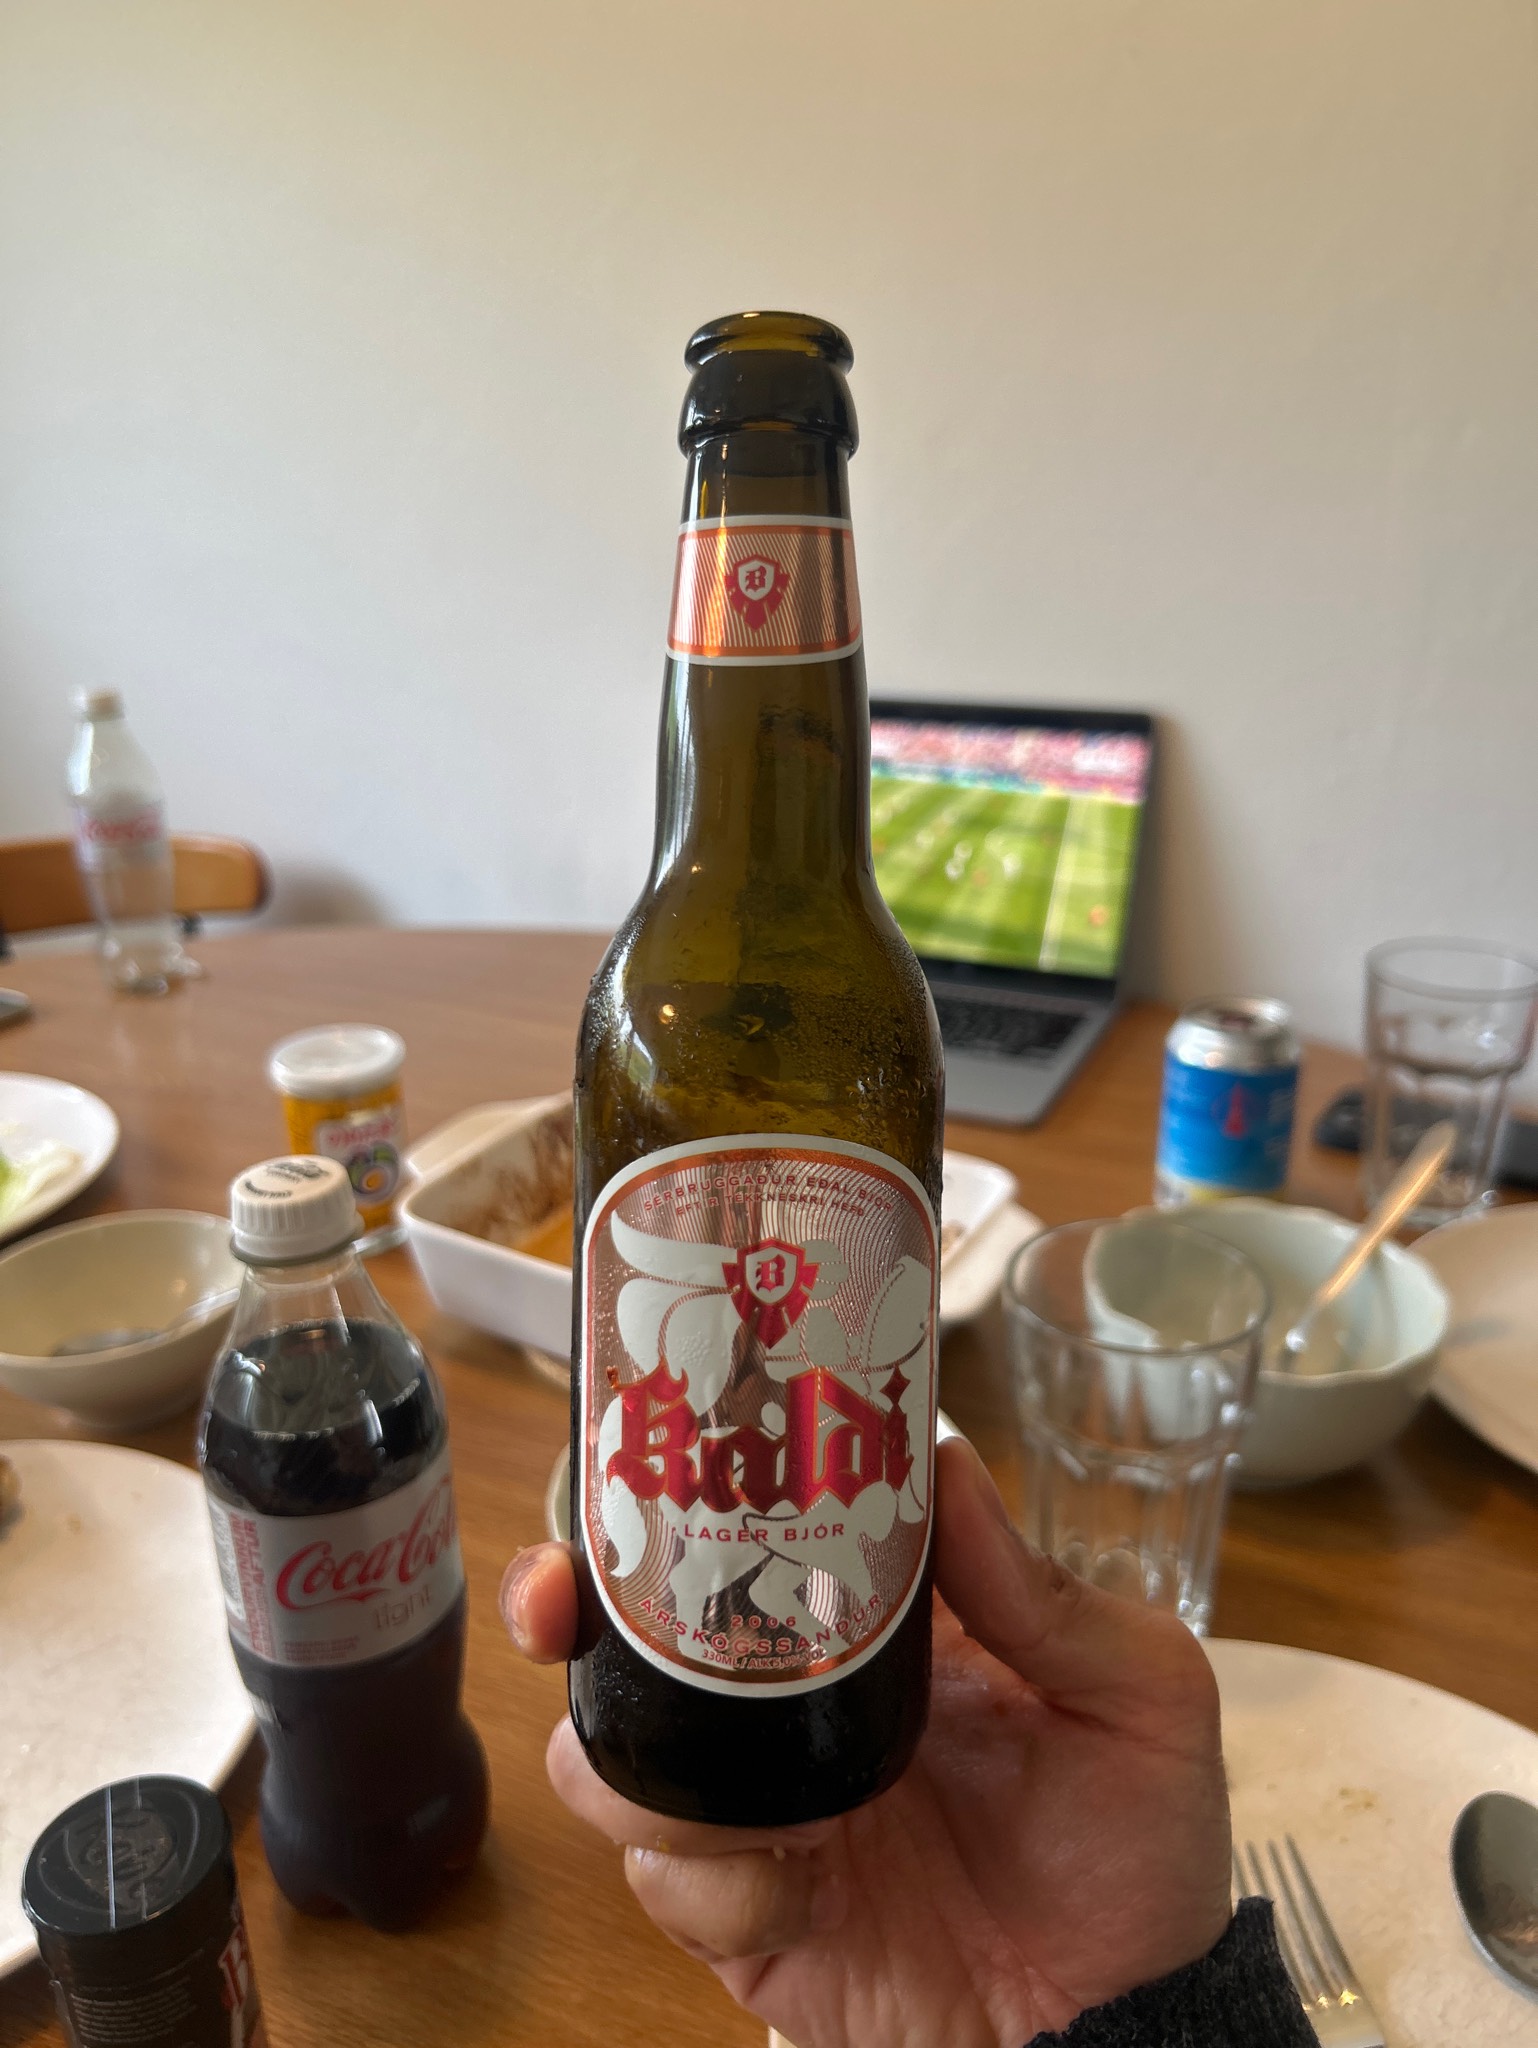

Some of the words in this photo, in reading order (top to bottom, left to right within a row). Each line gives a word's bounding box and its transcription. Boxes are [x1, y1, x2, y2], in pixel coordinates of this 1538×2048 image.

[745, 565, 767, 593] B
[755, 1253, 786, 1292] B
[606, 1353, 914, 1515] Kaldi
[684, 1522, 769, 1543] LAGER
[784, 1522, 845, 1543] BJÓR
[731, 1614, 797, 1629] 2006
[703, 1649, 739, 1667] 330ML
